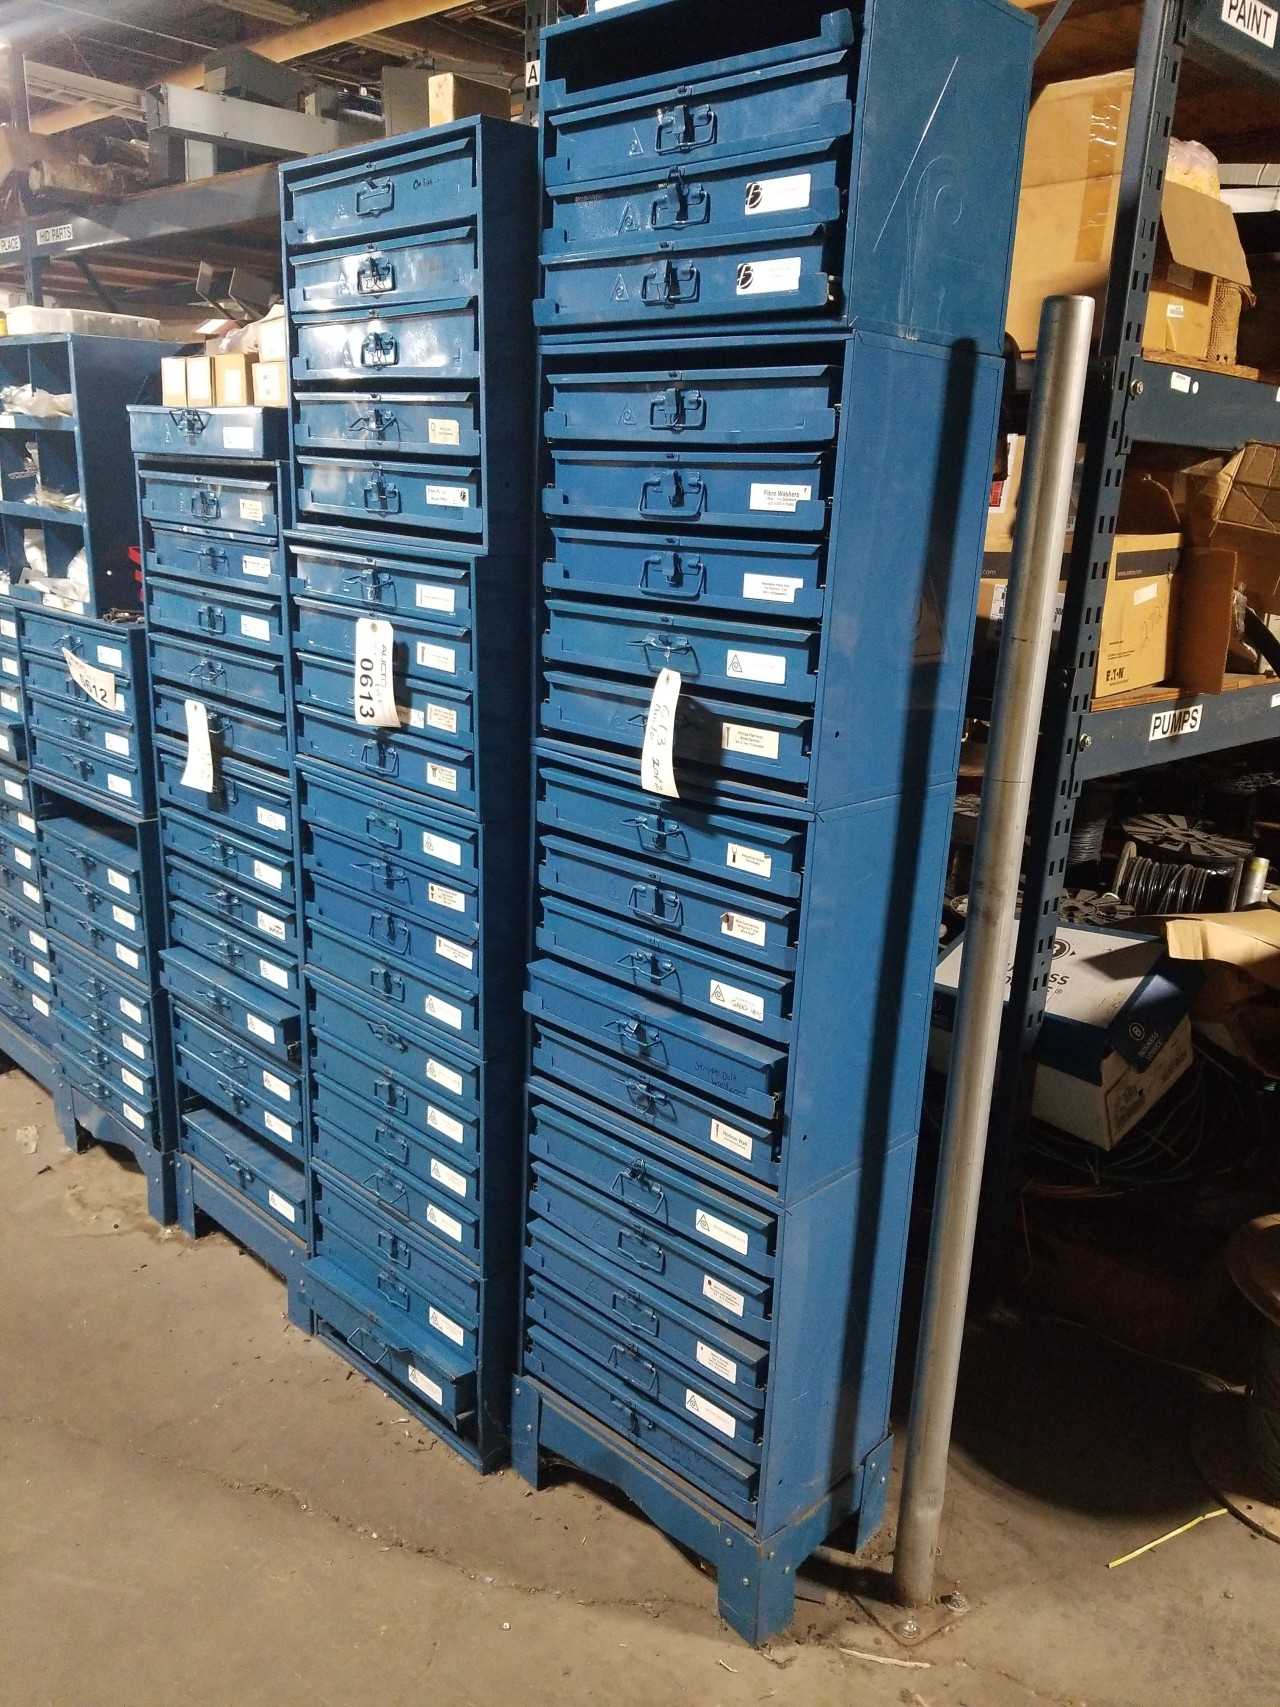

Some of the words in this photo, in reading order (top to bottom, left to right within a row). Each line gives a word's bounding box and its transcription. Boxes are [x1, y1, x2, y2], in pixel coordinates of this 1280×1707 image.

[1228, 0, 1272, 38] PAINT
[528, 64, 538, 84] A
[51, 226, 73, 241] PARTS
[359, 657, 376, 719] 0613
[1151, 708, 1199, 737] PUMPS
